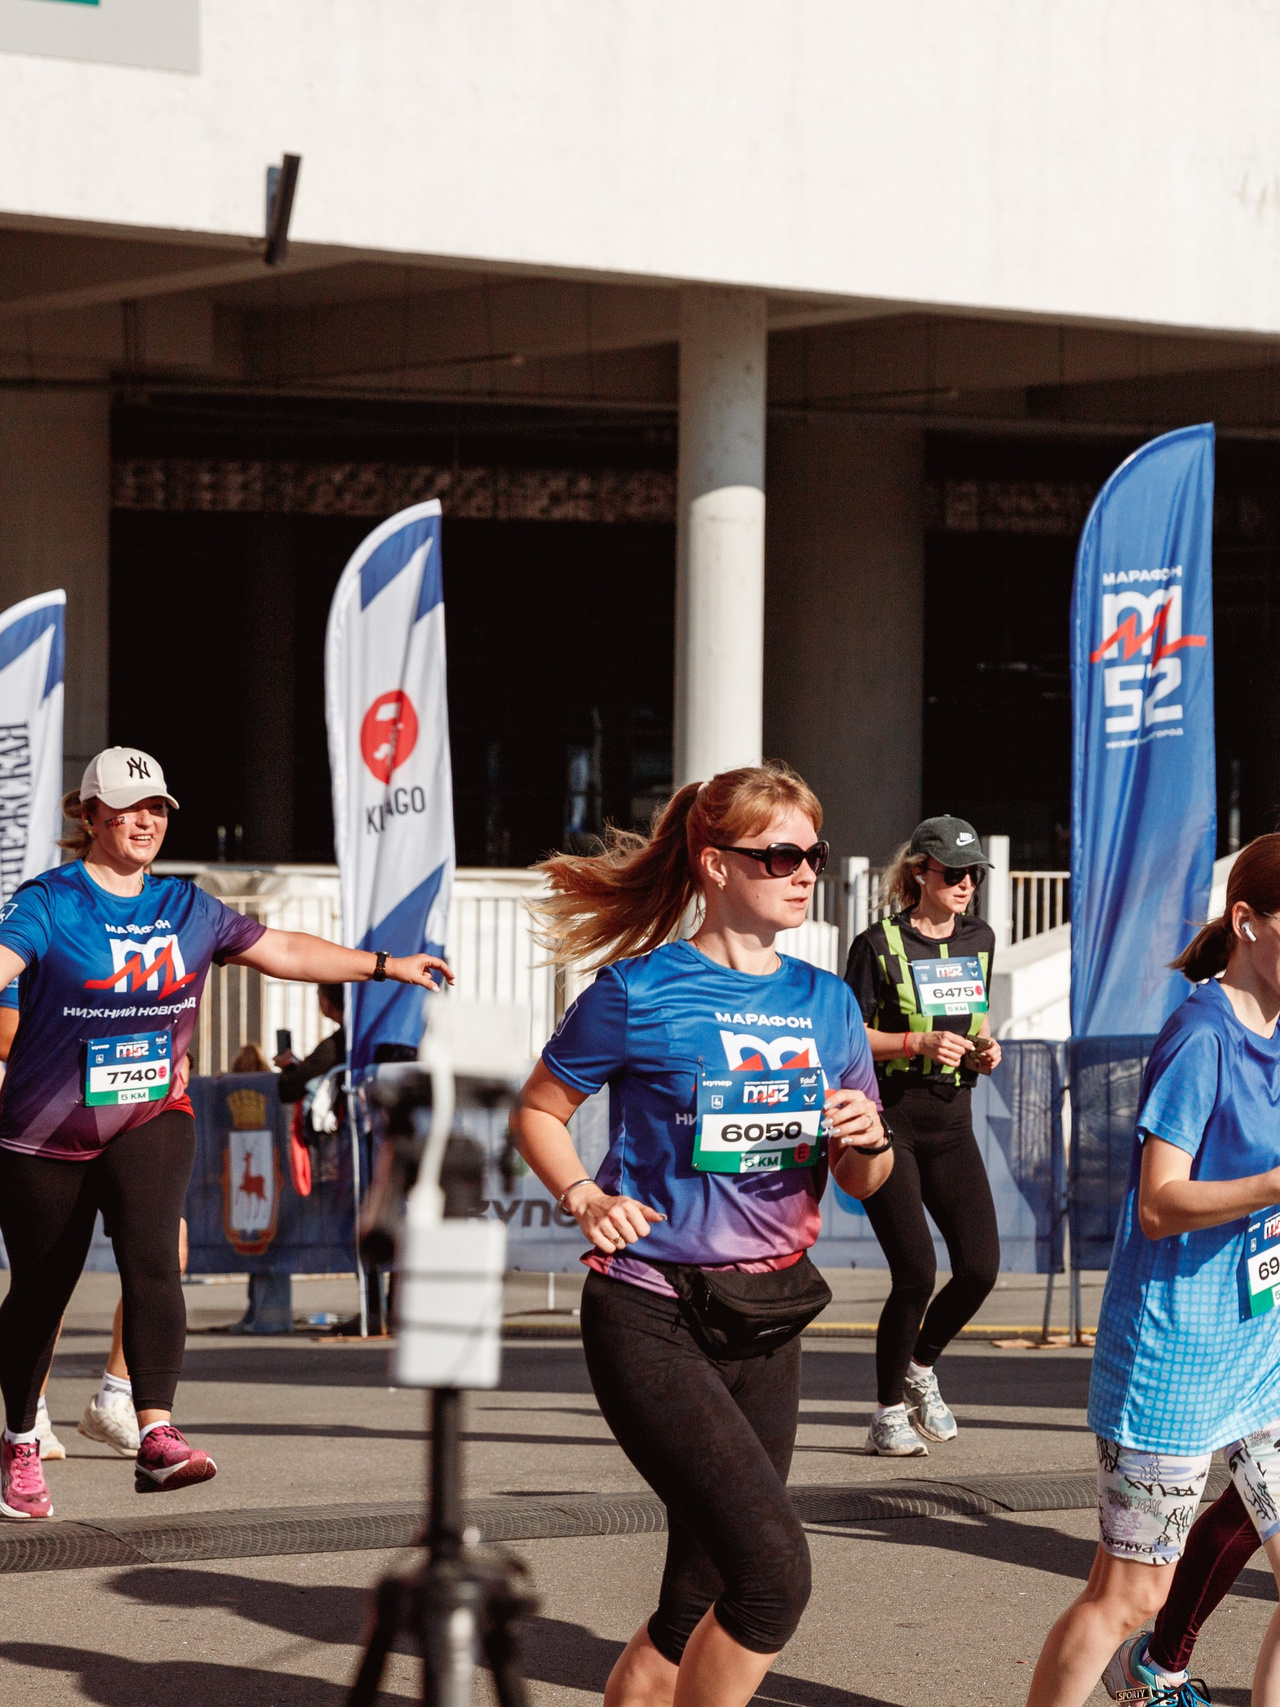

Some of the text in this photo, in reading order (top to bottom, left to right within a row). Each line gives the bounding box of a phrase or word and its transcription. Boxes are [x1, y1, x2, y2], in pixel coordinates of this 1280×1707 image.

[1103, 565, 1182, 586] МАРАФОН
[1104, 657, 1183, 734] 52
[126, 756, 151, 779] NY
[932, 986, 975, 999] 6475
[63, 1006, 137, 1018] НИЖНИЙ
[714, 1012, 814, 1030] МАРАФОН
[107, 1068, 157, 1085] 7740
[720, 1121, 803, 1143] 6050
[745, 1158, 755, 1168] 5
[758, 1156, 779, 1168] KM
[1275, 1290, 1280, 1300] 5
[1118, 1688, 1146, 1701] SPORTY
